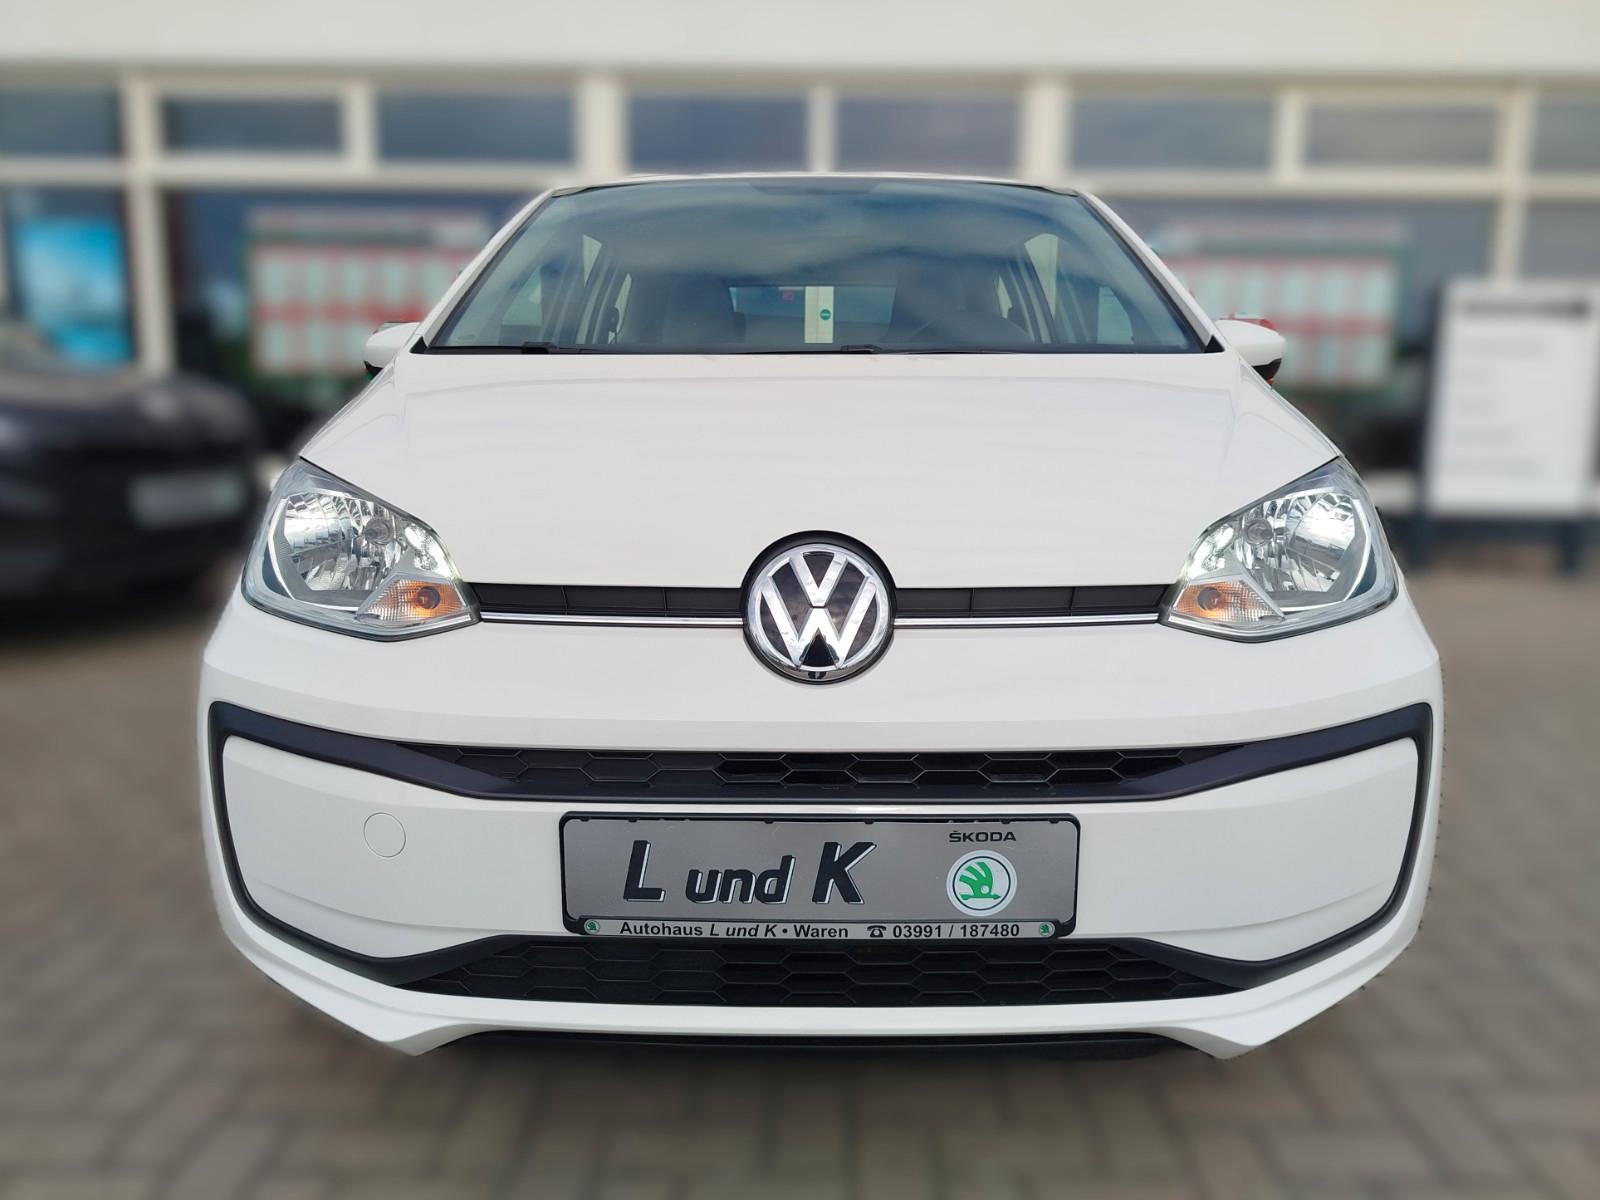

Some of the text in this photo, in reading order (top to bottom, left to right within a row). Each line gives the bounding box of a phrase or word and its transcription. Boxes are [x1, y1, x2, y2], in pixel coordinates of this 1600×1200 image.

[949, 830, 1017, 843] ŠKODA
[622, 839, 878, 905] L und K
[619, 922, 703, 936] Autohaus
[709, 923, 721, 937] L
[725, 923, 760, 938] und
[763, 923, 778, 938] K
[793, 924, 849, 938] Waren
[892, 924, 942, 939] 03991
[959, 923, 1020, 938] 187480
